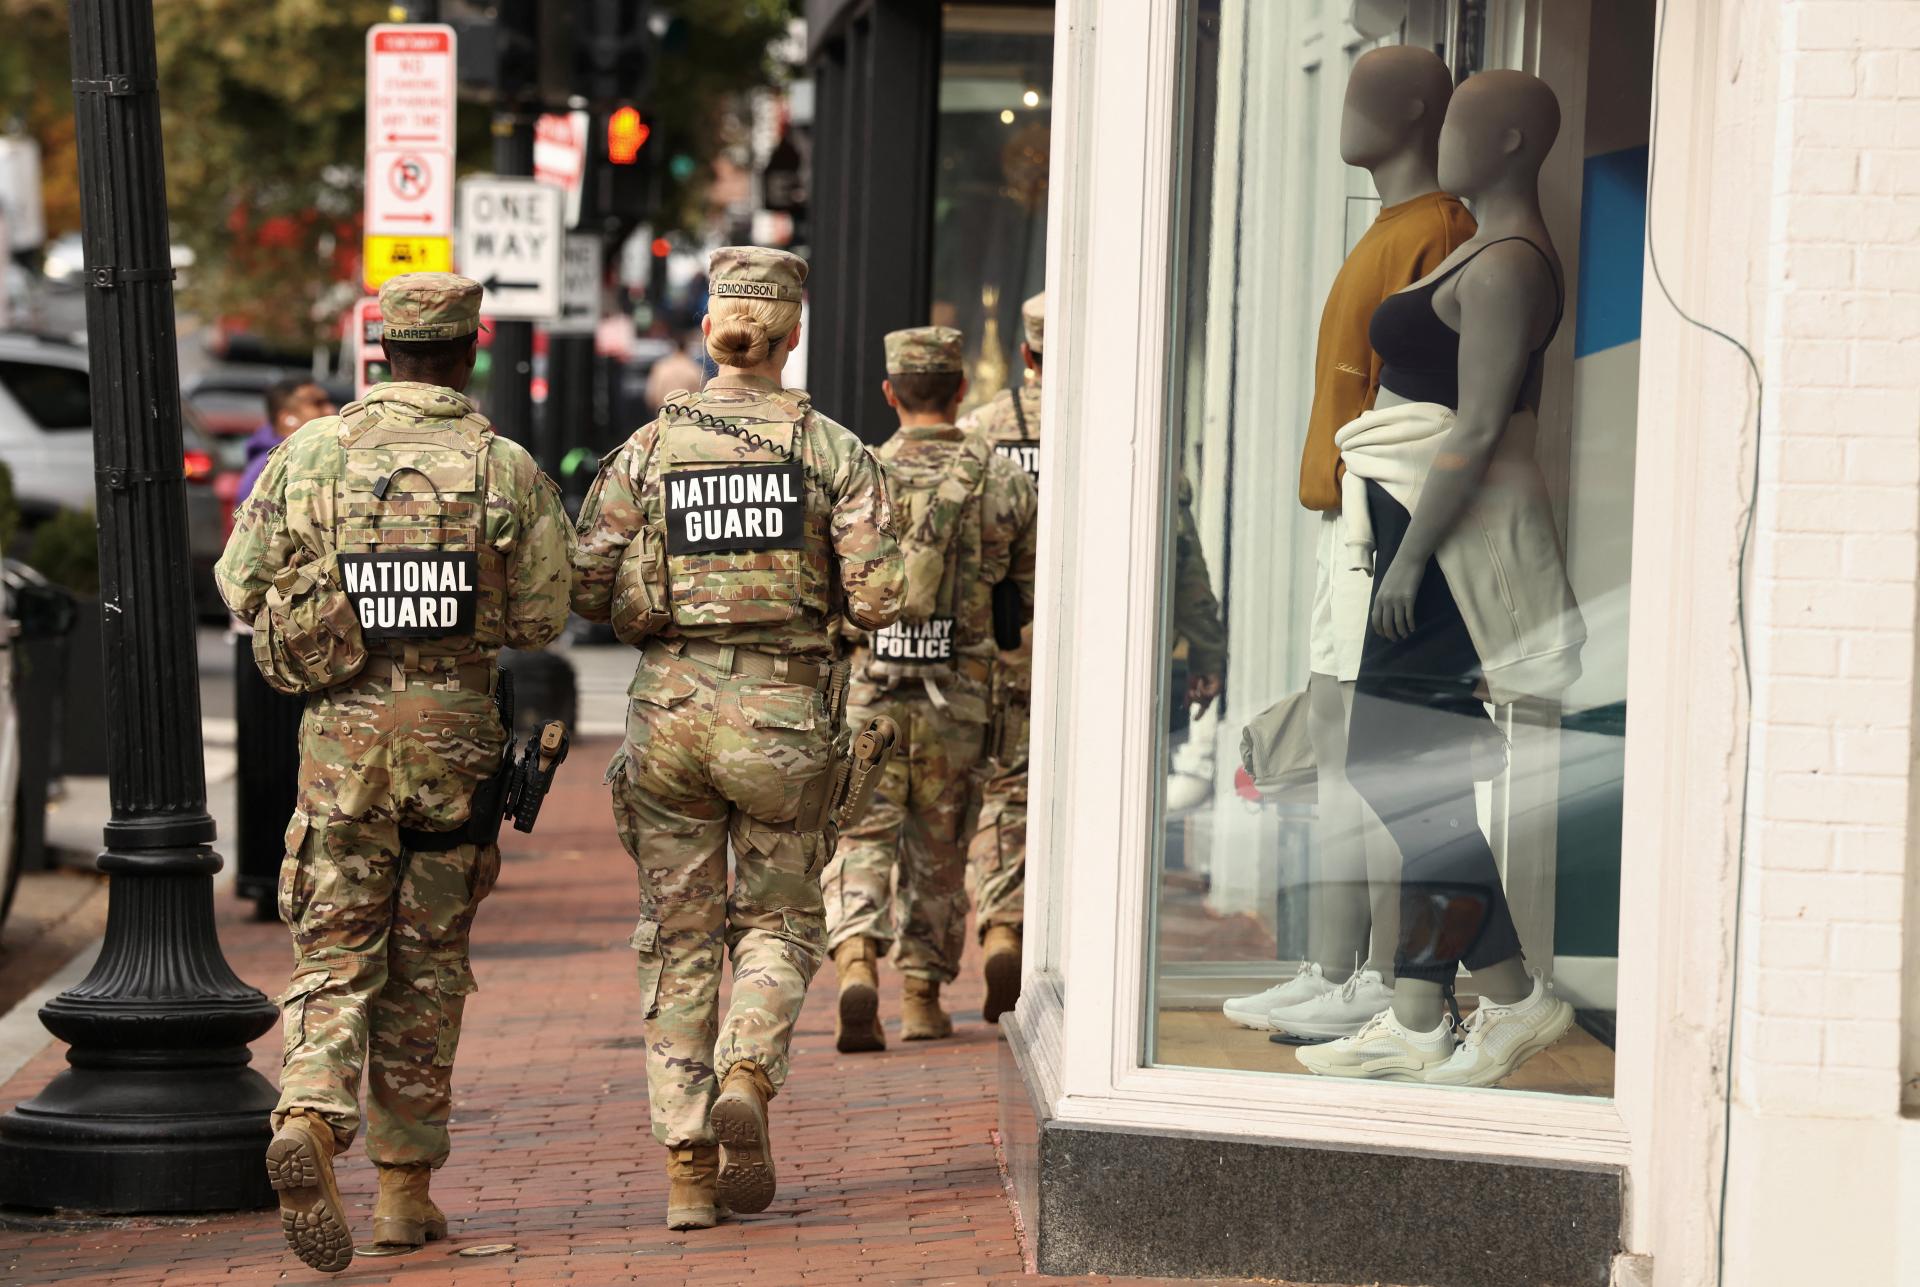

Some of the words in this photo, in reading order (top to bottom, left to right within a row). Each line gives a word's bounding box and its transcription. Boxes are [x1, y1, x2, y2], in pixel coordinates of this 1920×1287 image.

[473, 193, 544, 225] ONE
[474, 231, 546, 260] WAY
[717, 283, 773, 296] EDMONDSON
[391, 328, 441, 339] BARRETT
[671, 473, 798, 510] NATIONAL
[685, 507, 783, 542] GUARD
[344, 561, 473, 593] NATIONAL
[359, 597, 458, 629] GUARD
[876, 636, 951, 658] POLICE
